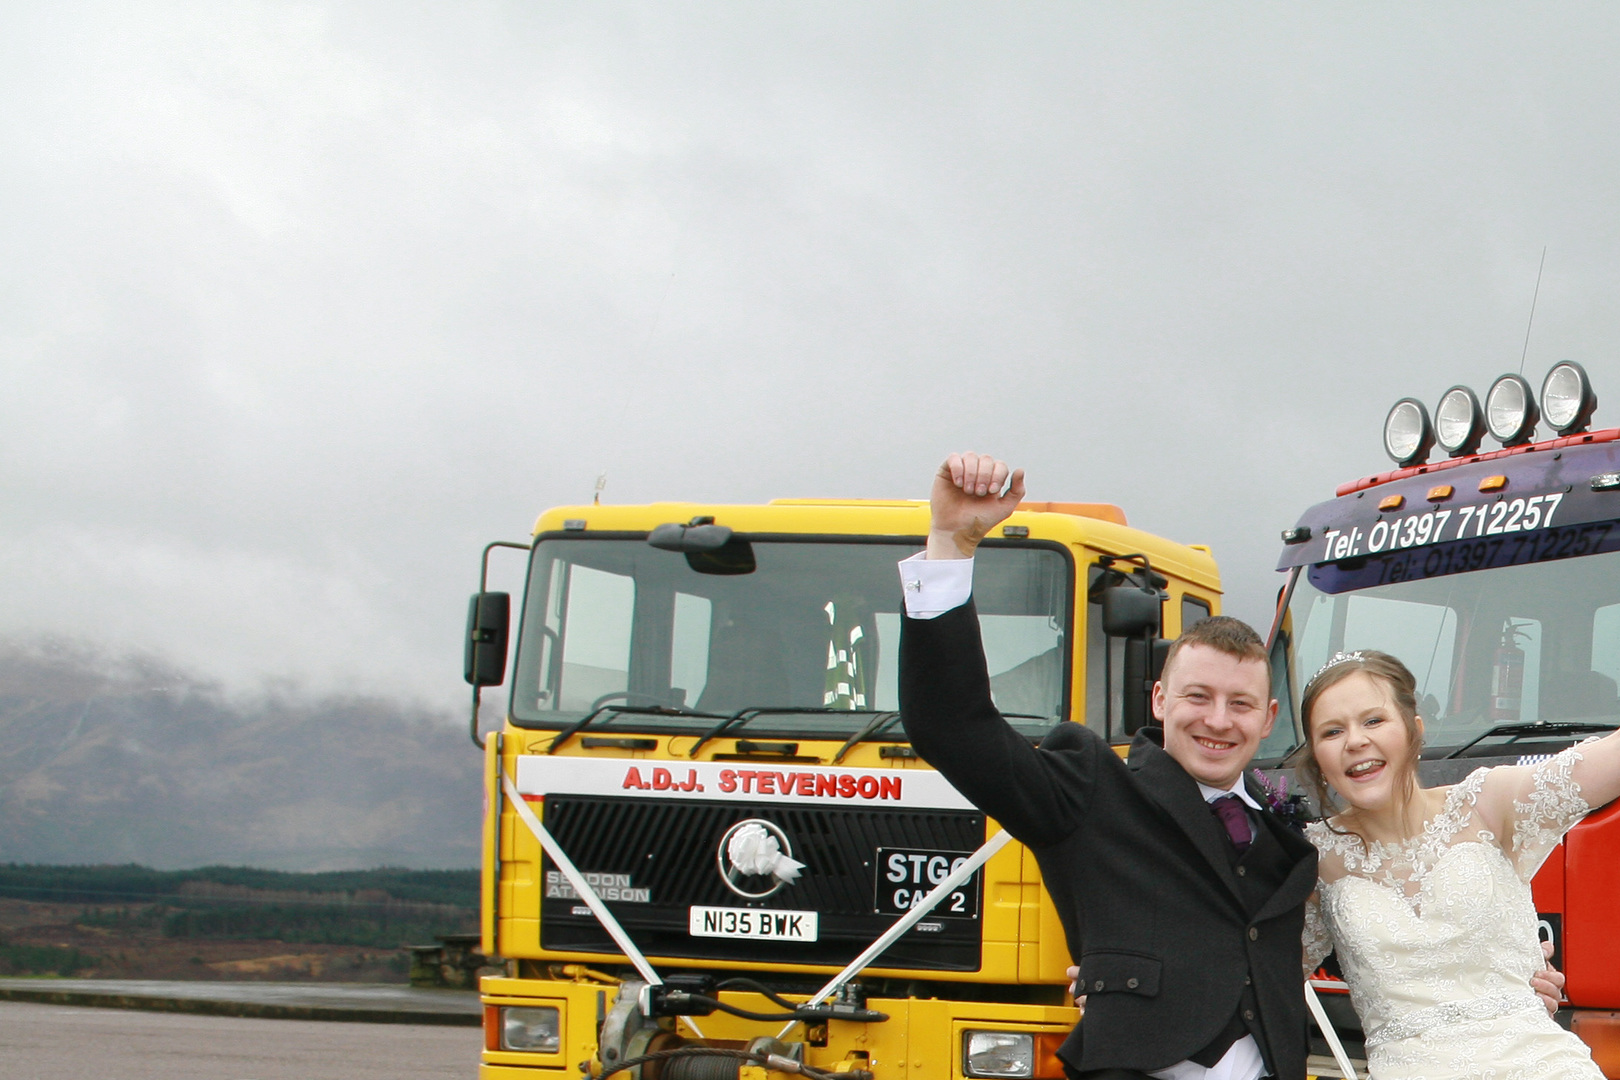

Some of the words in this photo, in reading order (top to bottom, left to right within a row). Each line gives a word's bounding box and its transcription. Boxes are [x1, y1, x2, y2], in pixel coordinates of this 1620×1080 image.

[1323, 528, 1364, 561] Tel:
[1367, 509, 1453, 553] 01397
[1455, 492, 1564, 539] 712257
[623, 766, 704, 792] A.D.J.
[718, 769, 902, 800] STEVENSON
[545, 870, 631, 888] SEDON
[893, 888, 937, 911] CA
[950, 892, 966, 913] 2
[758, 914, 803, 937] BWK
